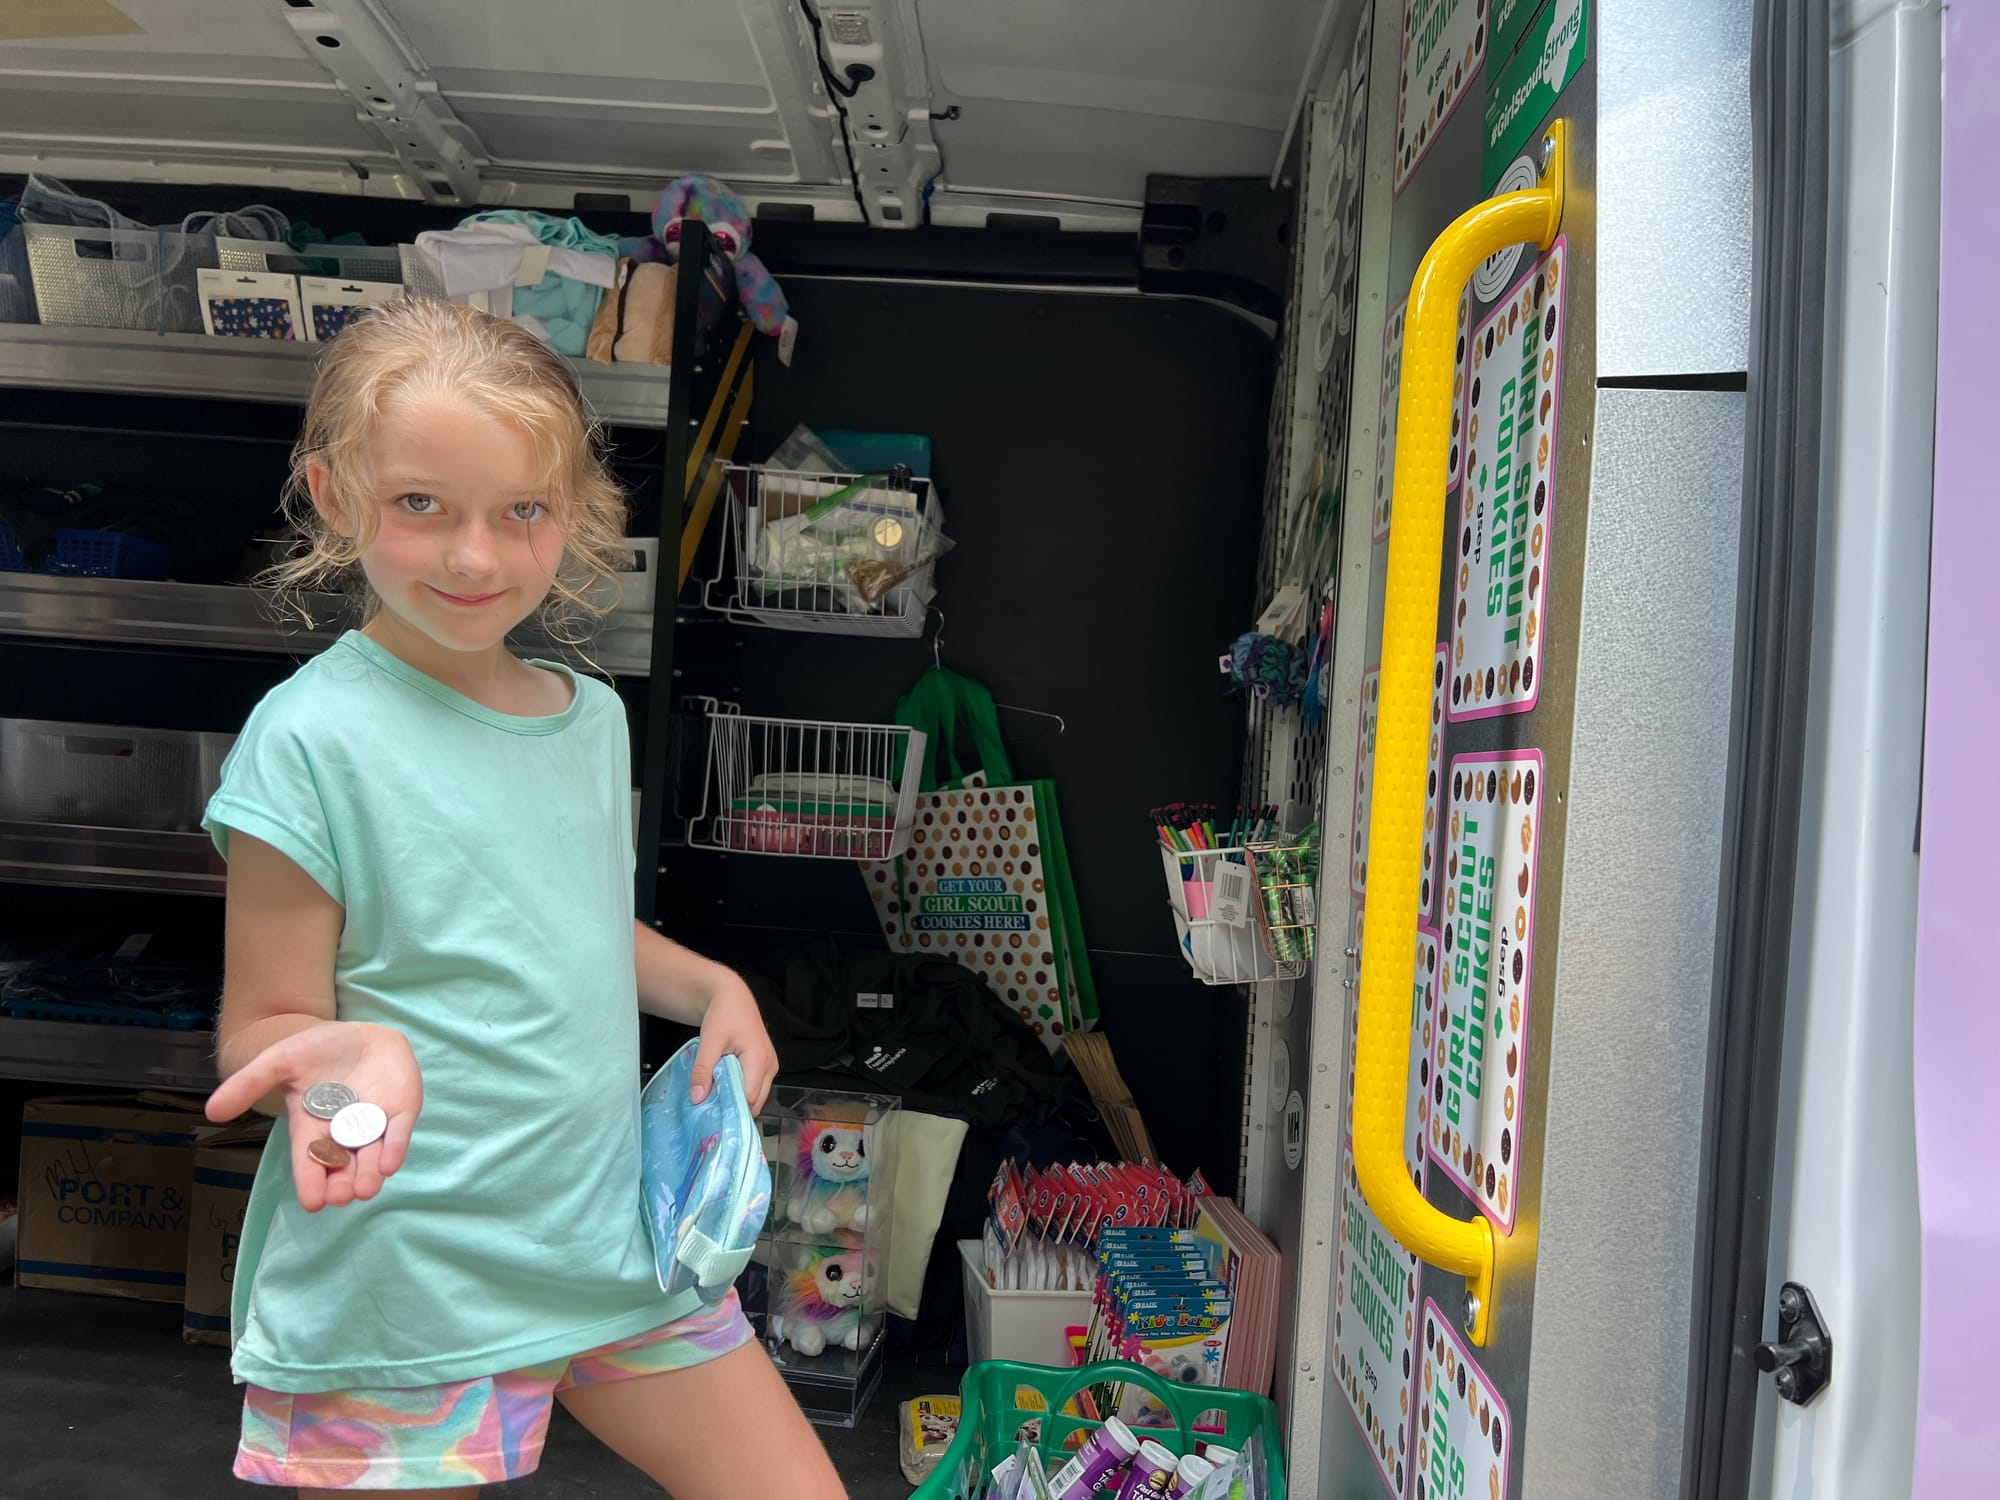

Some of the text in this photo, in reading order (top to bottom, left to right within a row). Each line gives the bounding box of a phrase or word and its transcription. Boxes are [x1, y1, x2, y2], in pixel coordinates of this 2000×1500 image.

[1487, 376, 1516, 617] COOKIES
[1504, 315, 1540, 650] GIRL SCOUT
[1474, 501, 1484, 564] gsep
[925, 895, 1018, 913] GIRL SCOUT
[939, 879, 1003, 893] GET YOUR
[921, 915, 1026, 929] COOKIES HERE!
[1446, 811, 1479, 1125] GIRL SCOUT
[1466, 855, 1495, 1100] COOKIES
[1498, 925, 1509, 998] gsep
[58, 1206, 185, 1232] COMPANY
[59, 1179, 183, 1210] PORT &
[1348, 1200, 1406, 1316] GIRL SCOUT
[1136, 1313, 1219, 1331] Kid's Paint
[1350, 1262, 1393, 1364] COOKIES
